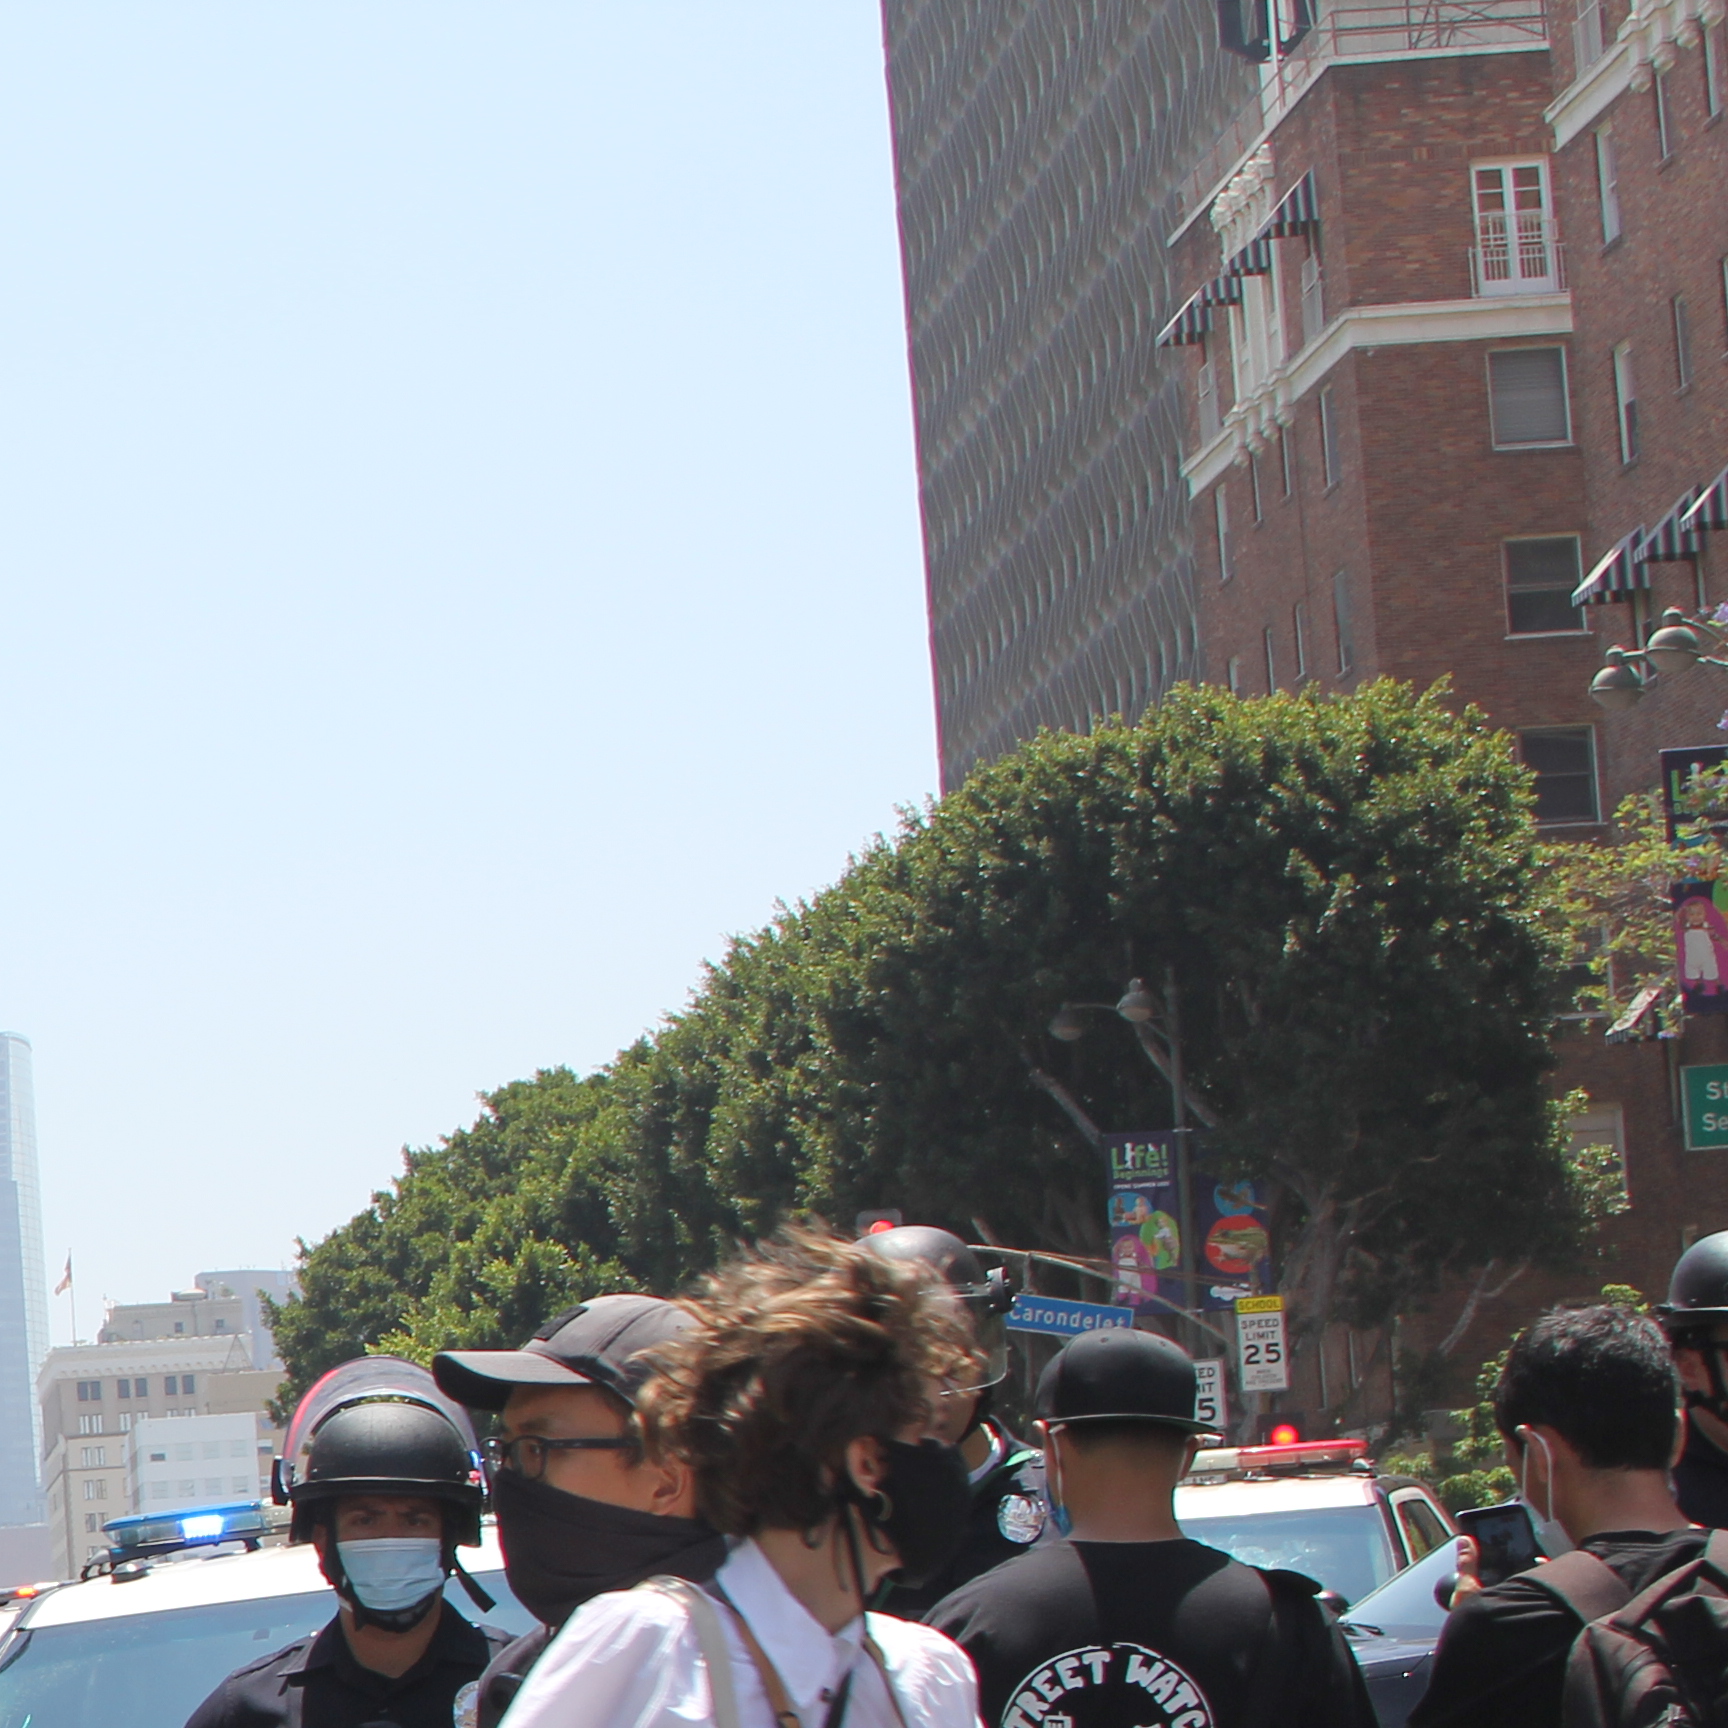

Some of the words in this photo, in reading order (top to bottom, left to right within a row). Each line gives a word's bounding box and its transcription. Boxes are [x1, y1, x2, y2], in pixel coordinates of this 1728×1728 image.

[1238, 1299, 1281, 1311] SCHOOL
[1009, 1303, 1126, 1329] Carondelet
[1240, 1318, 1279, 1330] SPEED
[1245, 1330, 1276, 1342] LIMIT
[1244, 1342, 1281, 1365] 25
[1197, 1397, 1216, 1423] 5
